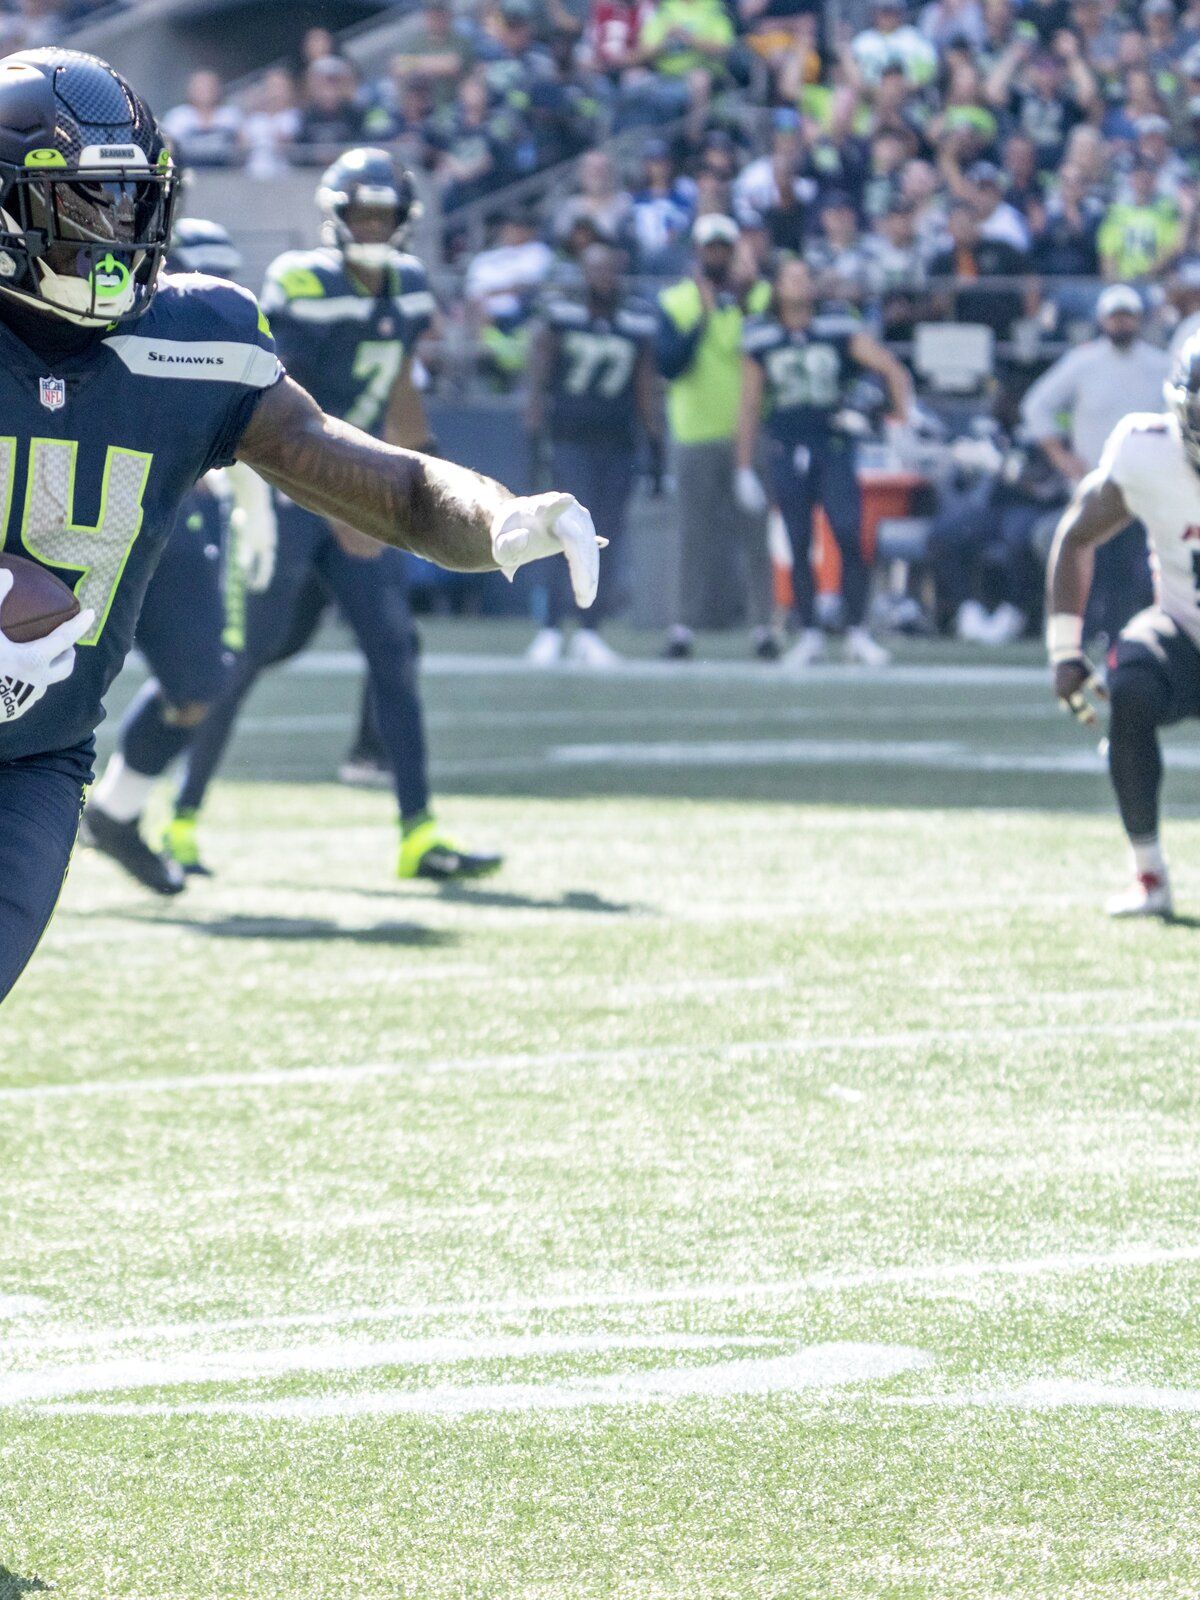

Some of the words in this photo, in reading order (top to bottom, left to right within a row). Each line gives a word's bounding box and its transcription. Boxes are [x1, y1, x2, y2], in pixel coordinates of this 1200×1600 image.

[147, 351, 225, 365] SEAHAWKS
[564, 330, 637, 398] 77
[44, 389, 61, 405] NFL
[344, 338, 404, 431] 7
